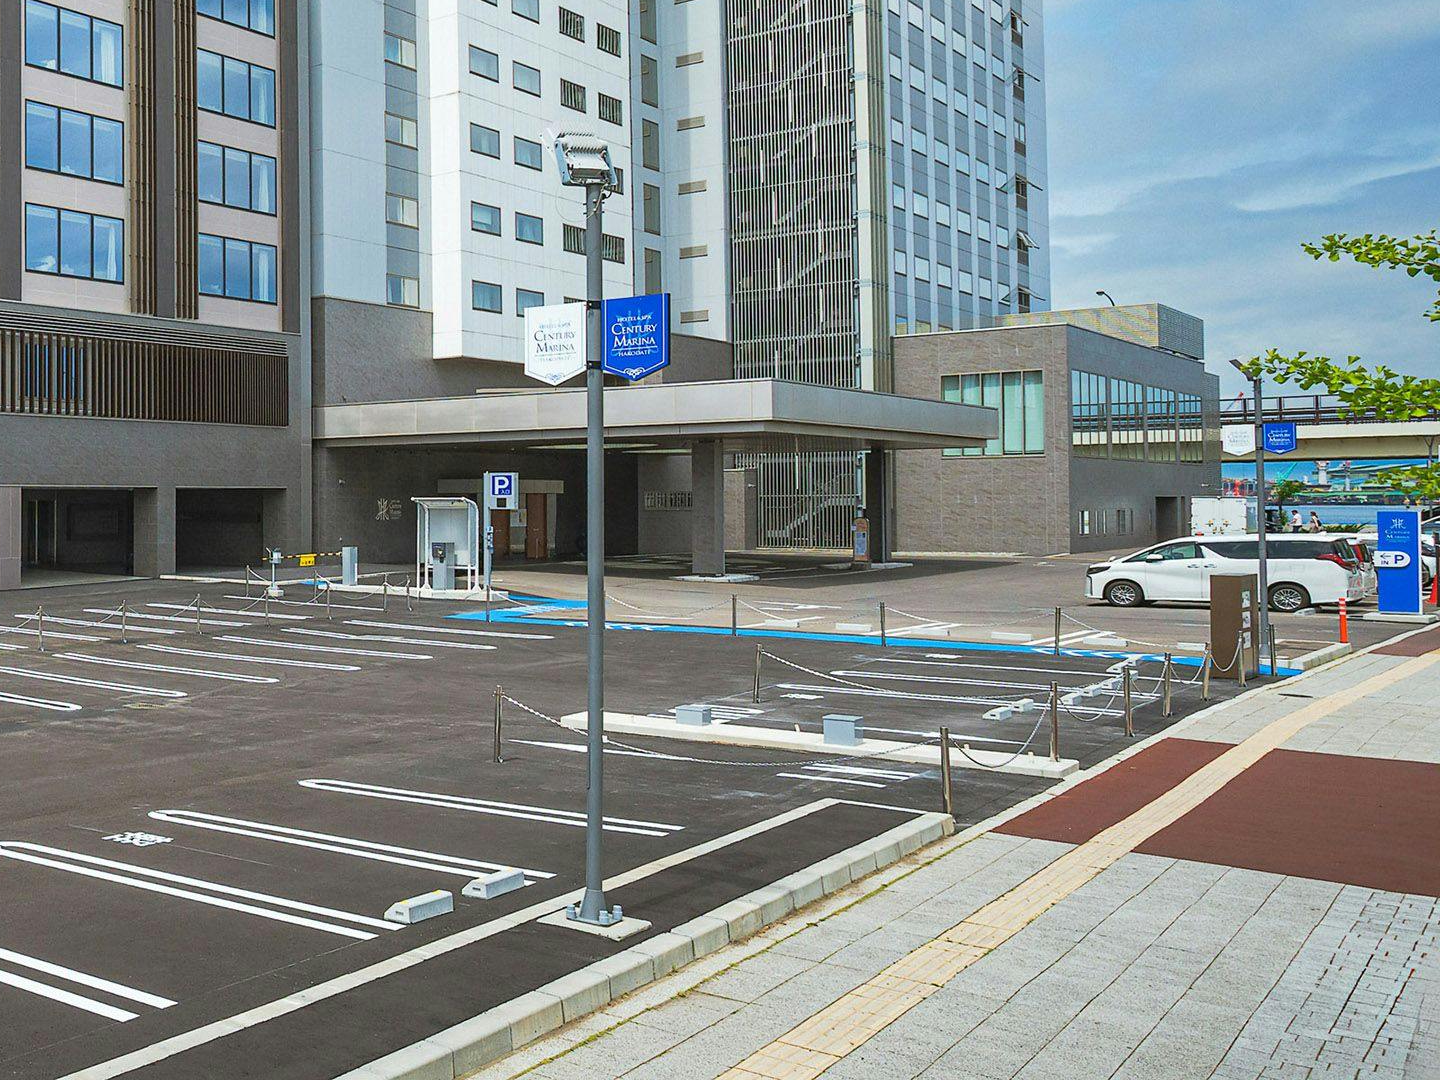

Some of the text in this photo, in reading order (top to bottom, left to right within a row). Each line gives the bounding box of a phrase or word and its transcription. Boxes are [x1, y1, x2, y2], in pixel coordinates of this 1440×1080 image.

[611, 323, 658, 335] CENTURY
[534, 330, 576, 341] CENTURY
[614, 335, 656, 348] MARINA
[536, 342, 575, 353] MARINA
[494, 476, 509, 495] P
[1394, 554, 1405, 564] P
